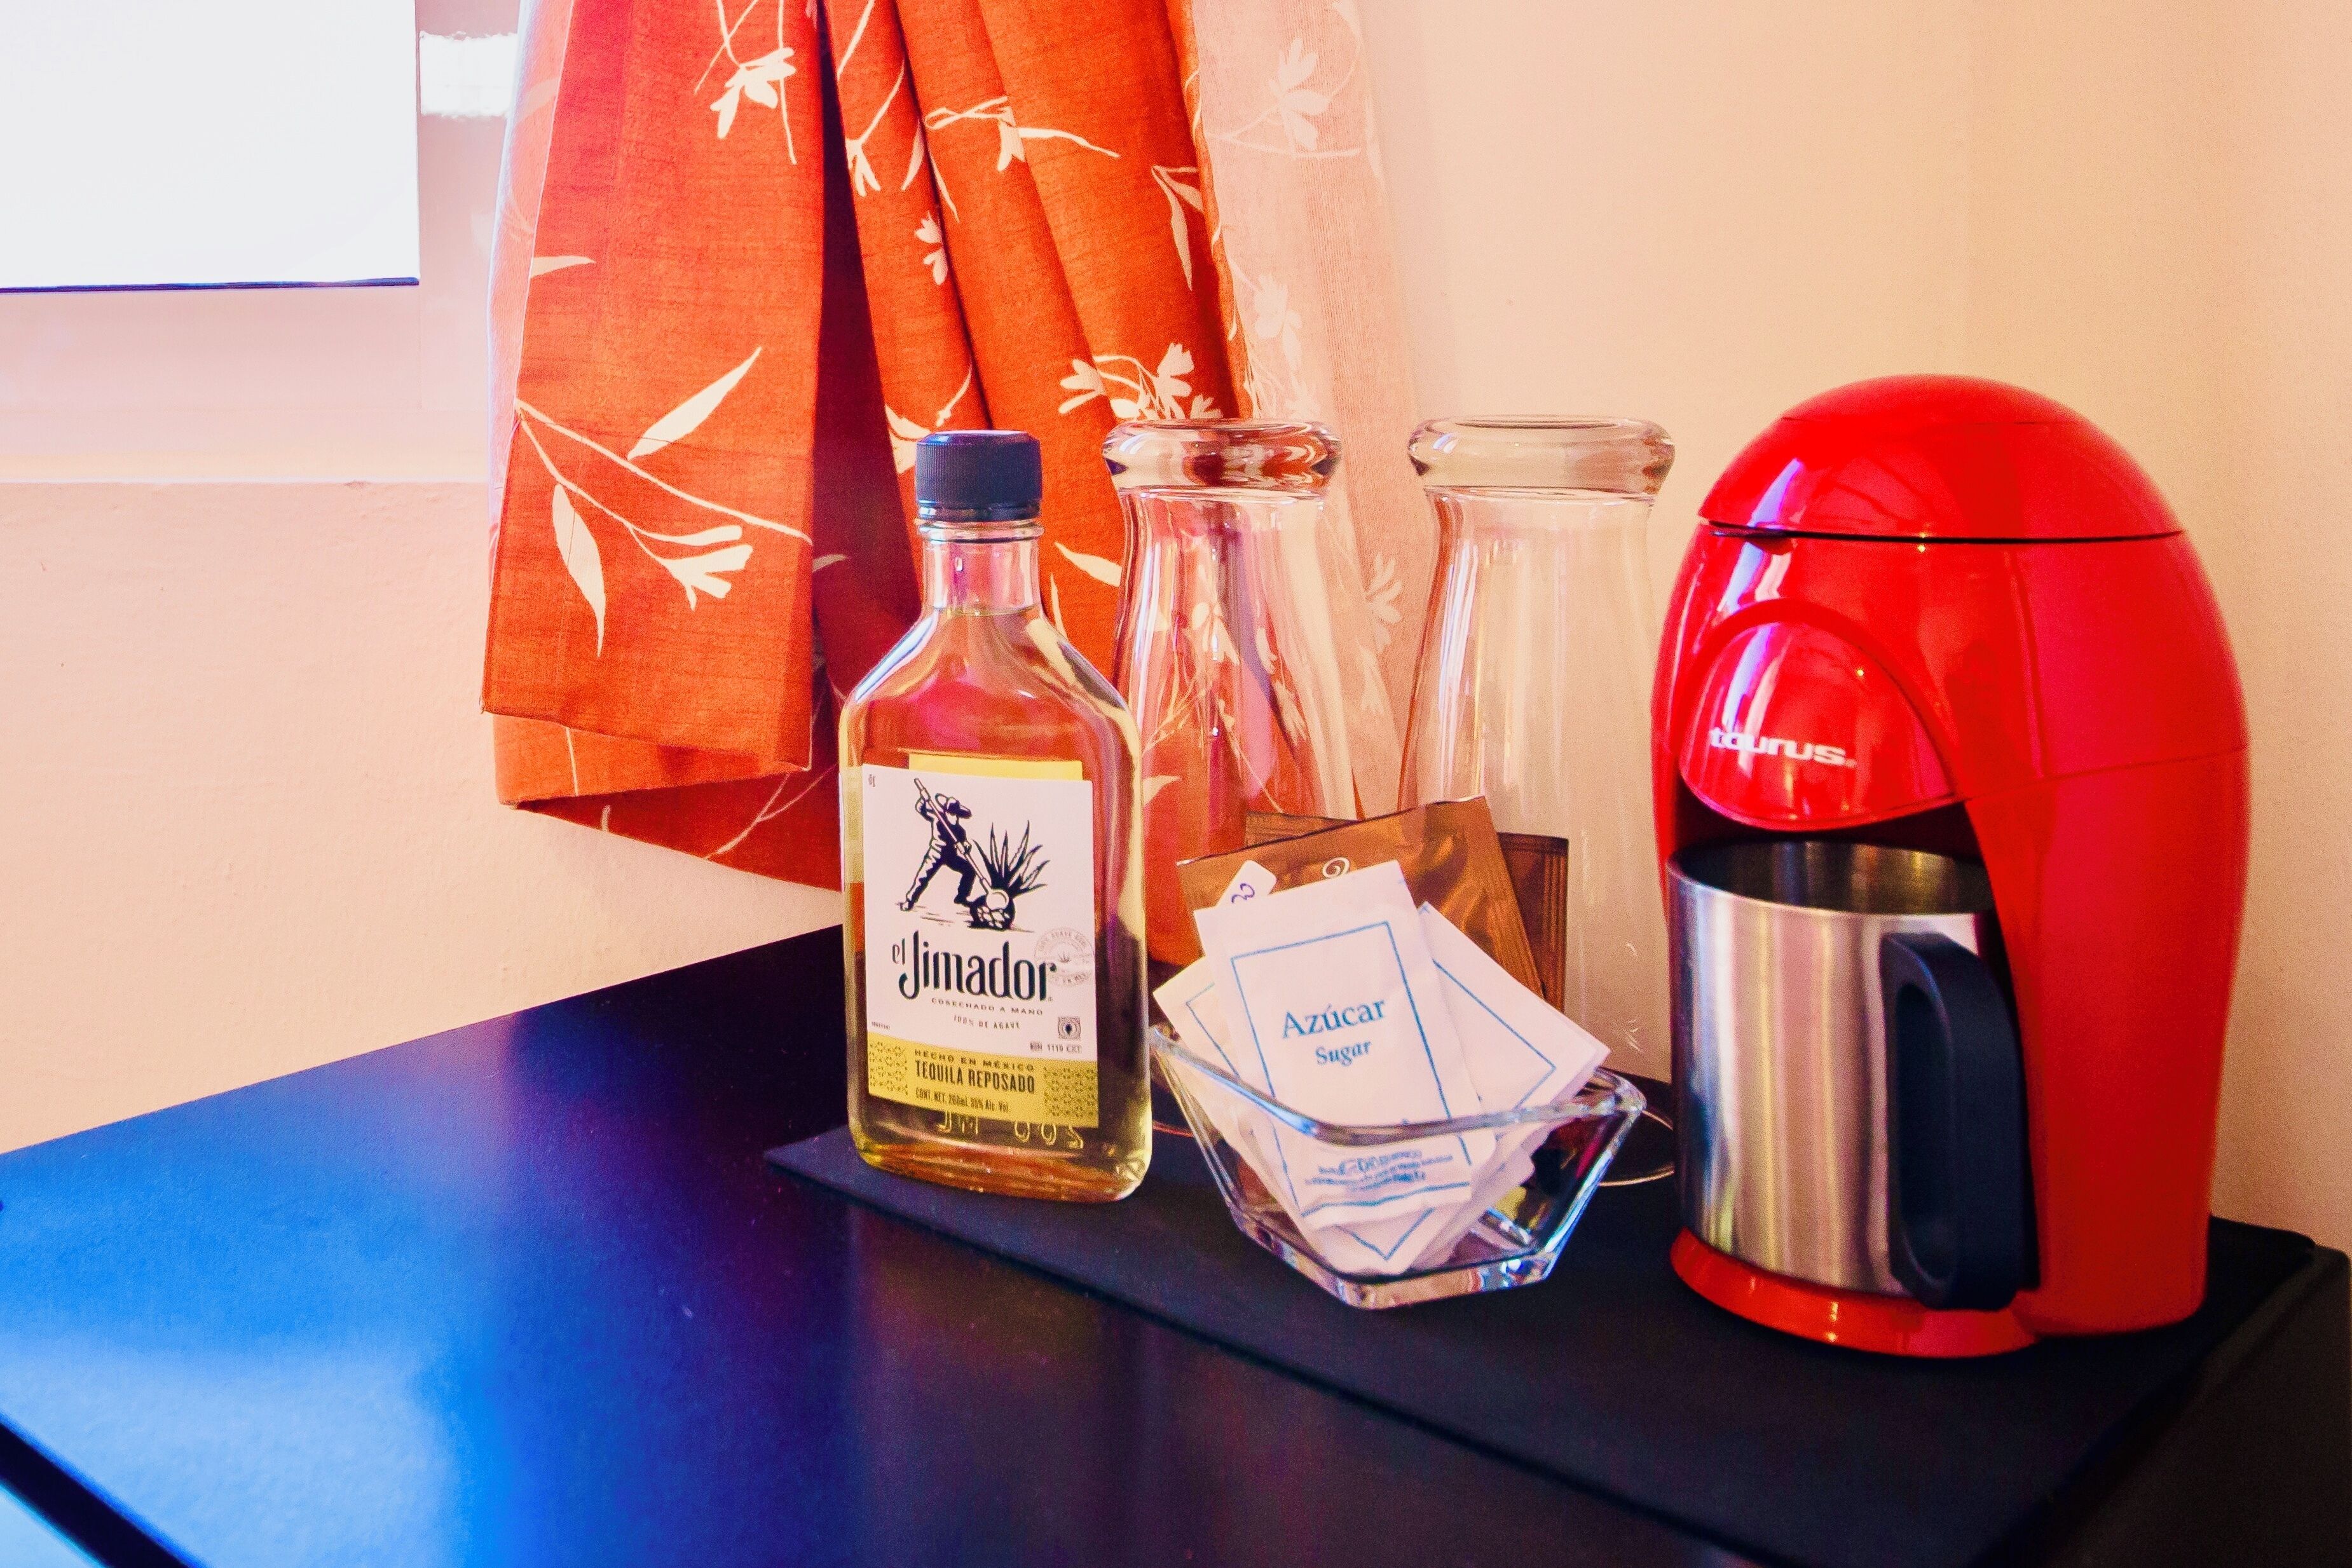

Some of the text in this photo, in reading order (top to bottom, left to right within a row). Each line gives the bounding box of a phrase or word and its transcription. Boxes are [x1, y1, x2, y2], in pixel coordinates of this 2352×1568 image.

[1709, 726, 1847, 767] taurus
[892, 930, 1058, 1002] el Jimador
[954, 1014, 1021, 1030] 100% DE AGAVE
[1011, 1007, 1043, 1016] MANO
[1282, 1000, 1385, 1039] Azúcar
[915, 1049, 954, 1063] HECHO
[961, 1057, 976, 1066] EN
[1315, 1041, 1372, 1067] Sugar
[915, 1060, 1035, 1094] TEQUILA REPOSADO
